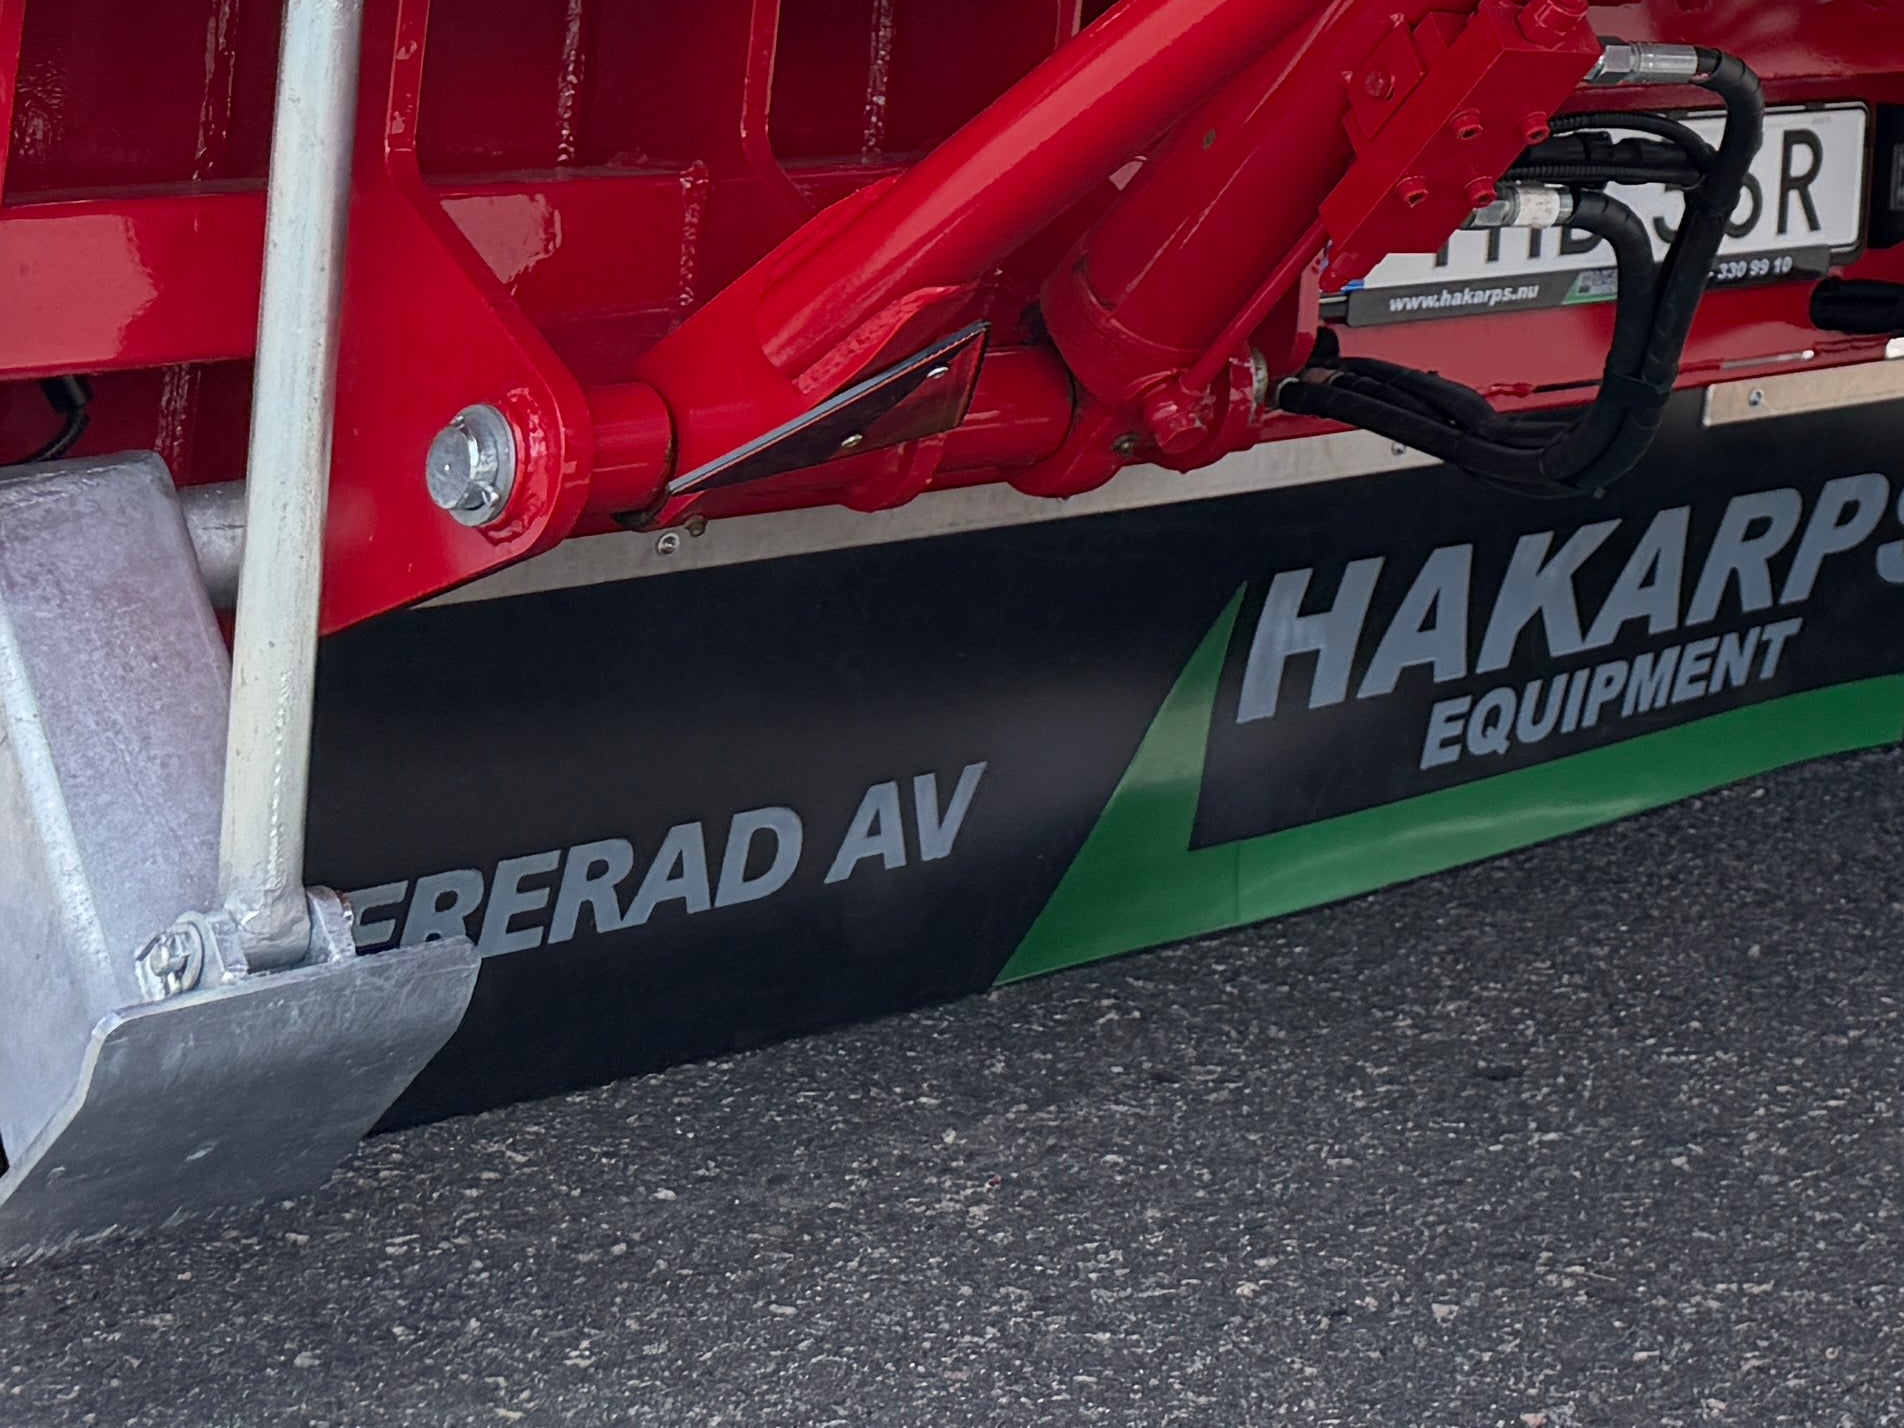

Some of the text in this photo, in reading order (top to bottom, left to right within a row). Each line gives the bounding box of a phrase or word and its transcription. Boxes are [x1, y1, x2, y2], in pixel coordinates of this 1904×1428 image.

[1388, 282, 1541, 313] www.hakarps.nu
[1773, 255, 1793, 274] 10
[1420, 618, 1804, 771] EQUIPMENT
[824, 760, 989, 885] AV
